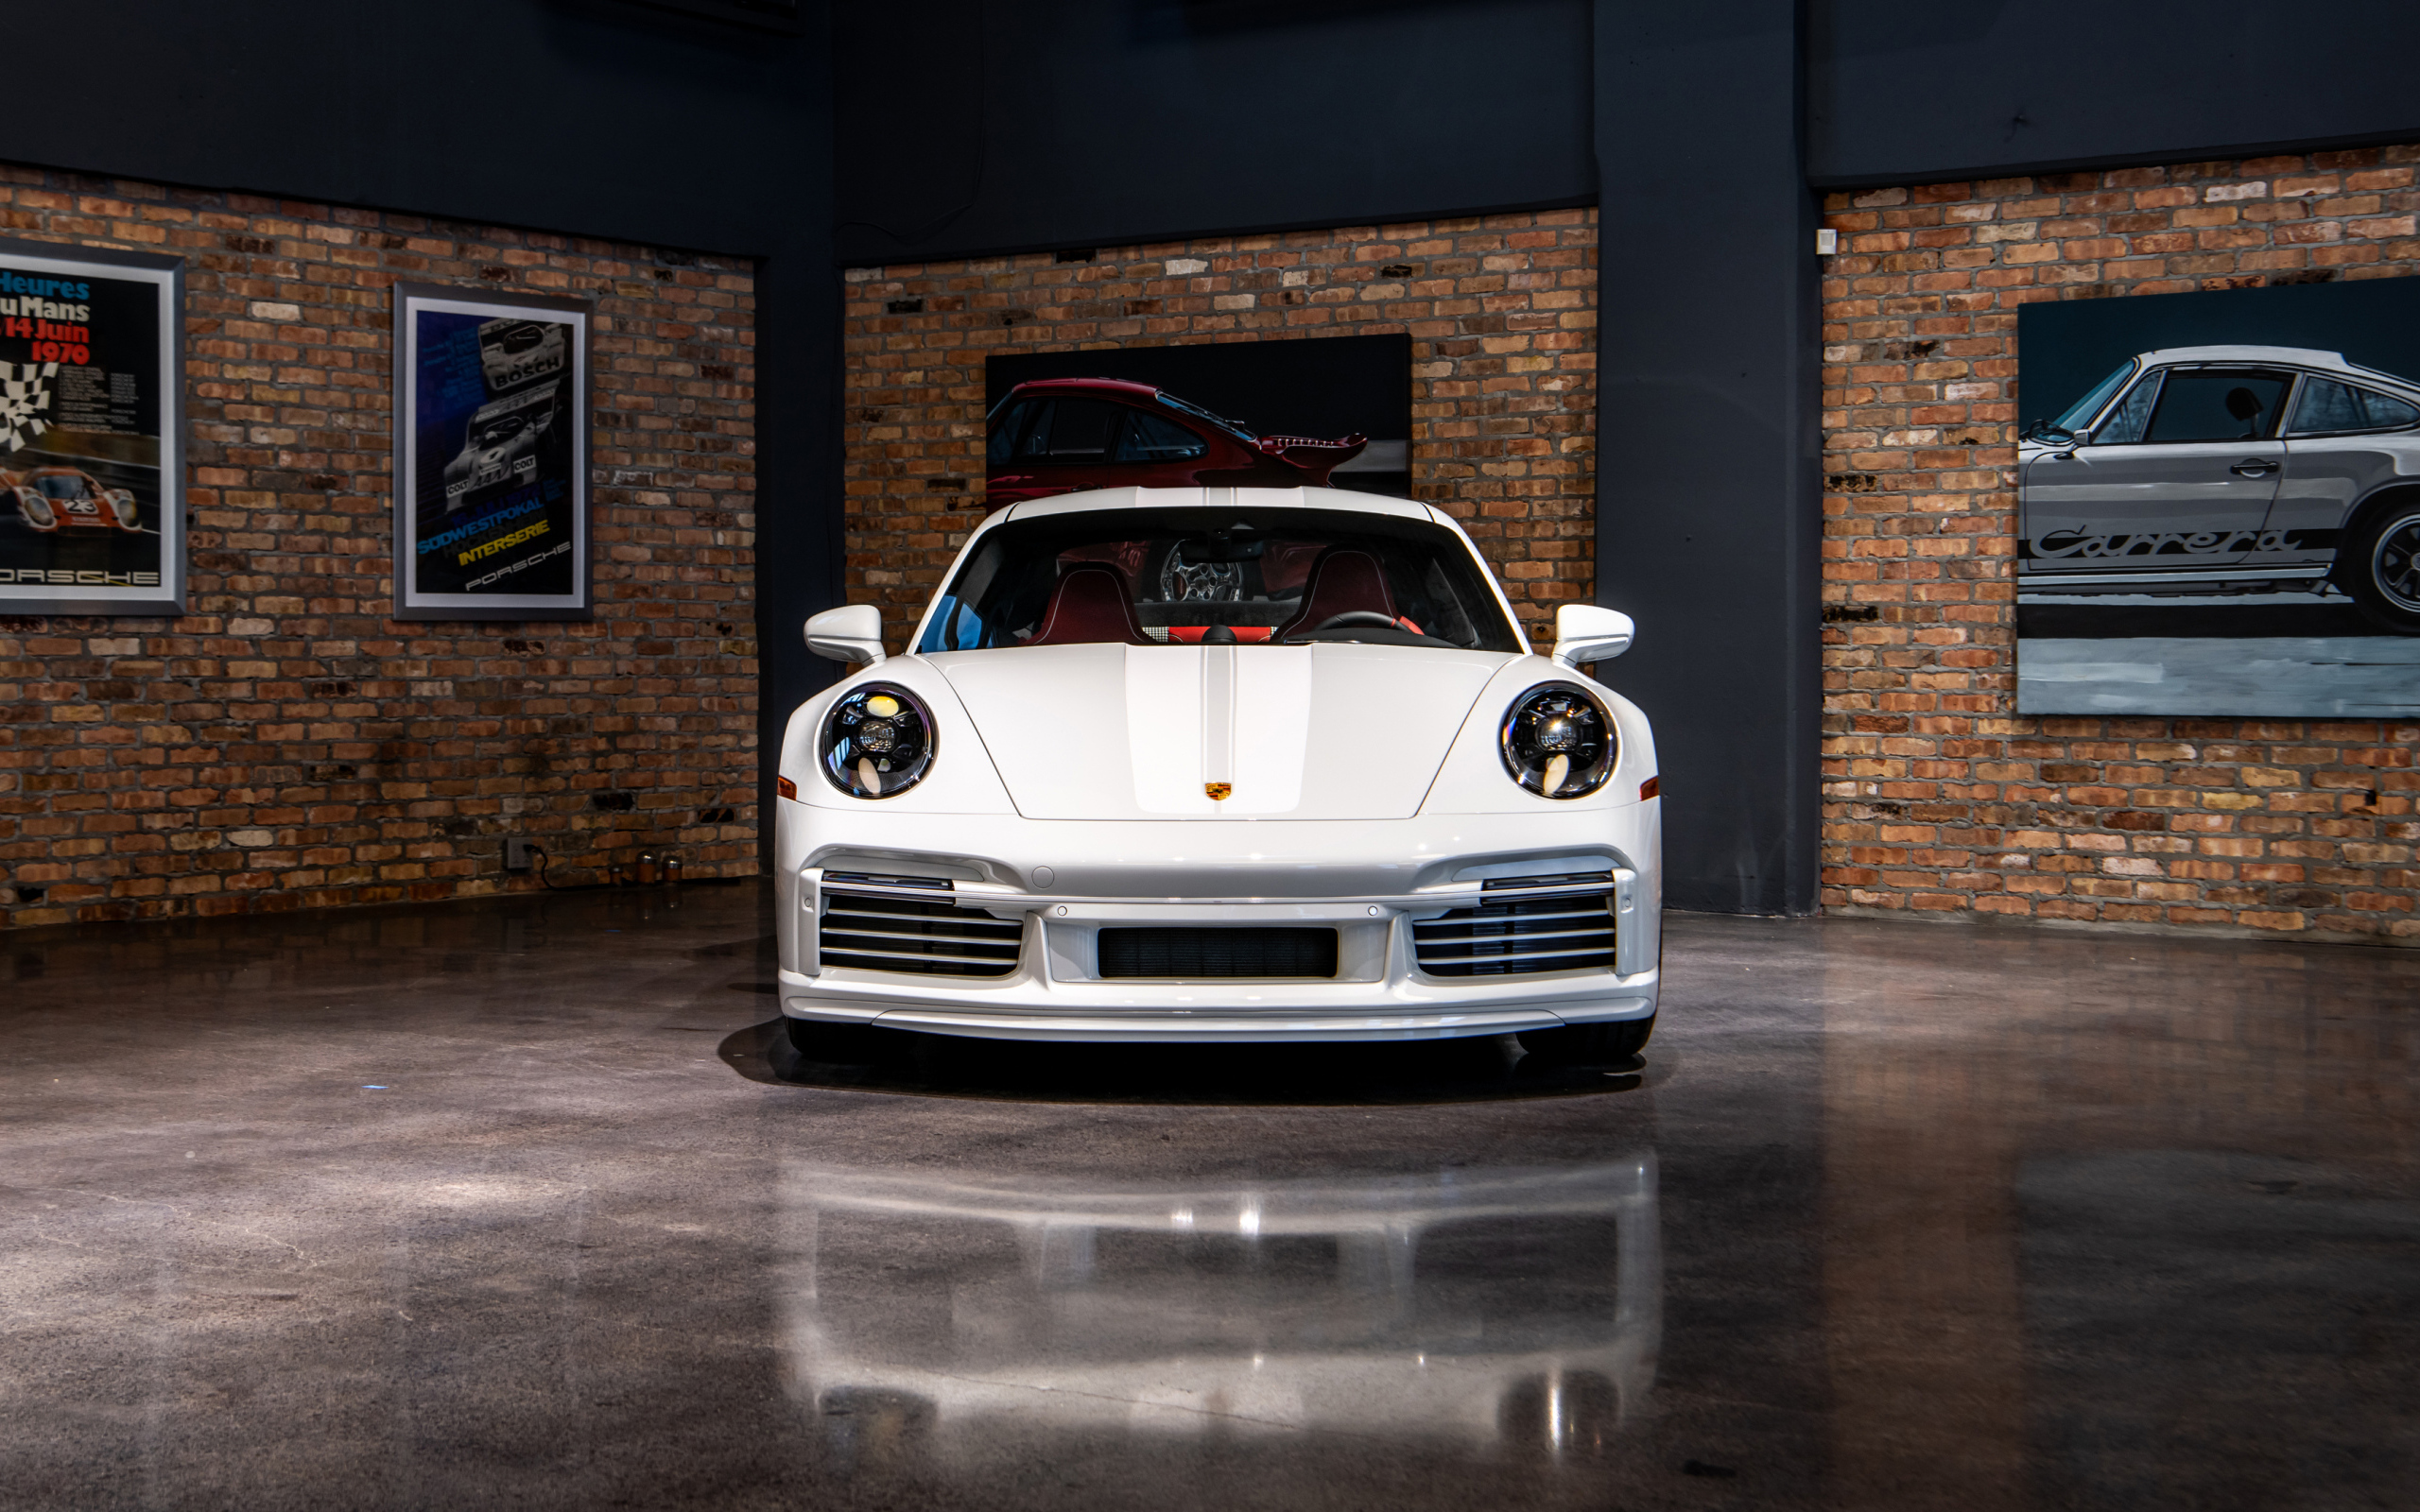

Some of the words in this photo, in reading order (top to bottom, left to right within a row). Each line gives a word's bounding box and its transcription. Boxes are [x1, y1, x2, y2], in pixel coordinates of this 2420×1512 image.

[20, 296, 91, 322] Mans
[34, 318, 90, 343] Juin
[32, 341, 90, 365] 1970
[495, 355, 560, 388] BOSCH
[514, 457, 534, 471] COLT
[448, 480, 469, 494] COLT
[64, 500, 96, 512] 23
[458, 519, 550, 567] INTERSERIE
[2029, 524, 2303, 558] Carrera
[465, 541, 571, 591] PORSCHE
